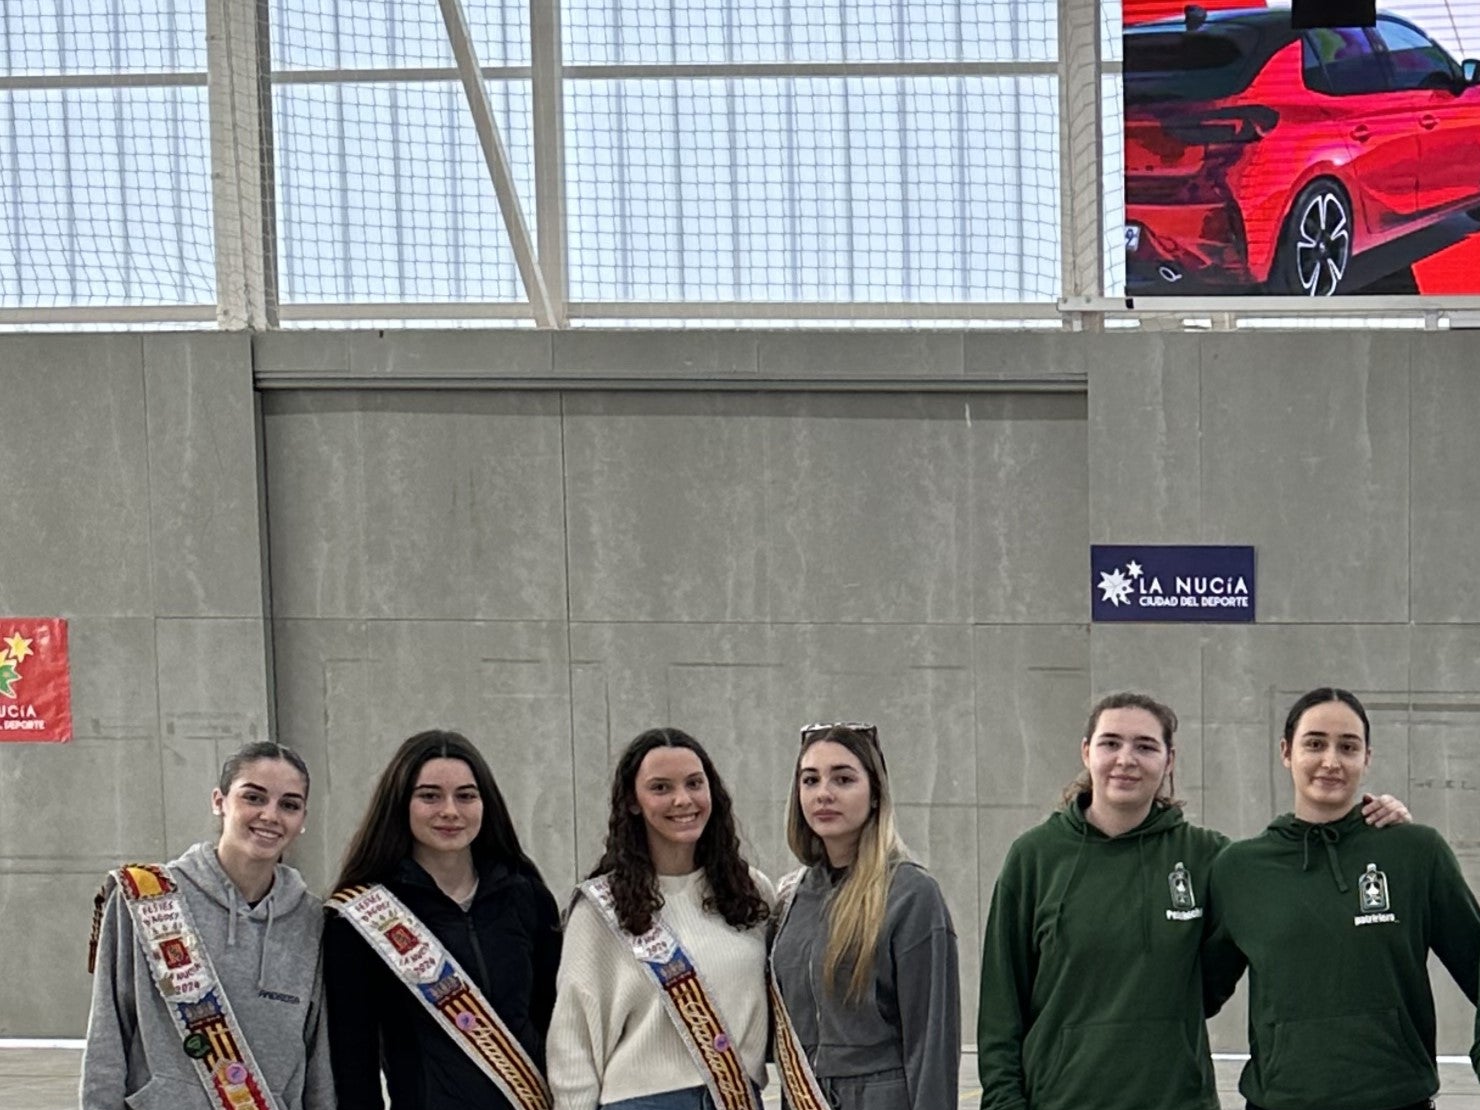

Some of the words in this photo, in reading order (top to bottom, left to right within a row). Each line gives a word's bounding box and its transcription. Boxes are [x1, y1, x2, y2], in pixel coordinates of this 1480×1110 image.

[1140, 576, 1163, 594] LA
[1139, 596, 1178, 607] CIUDAD
[1180, 596, 1200, 607] DEL
[1201, 596, 1249, 607] DEPORTE
